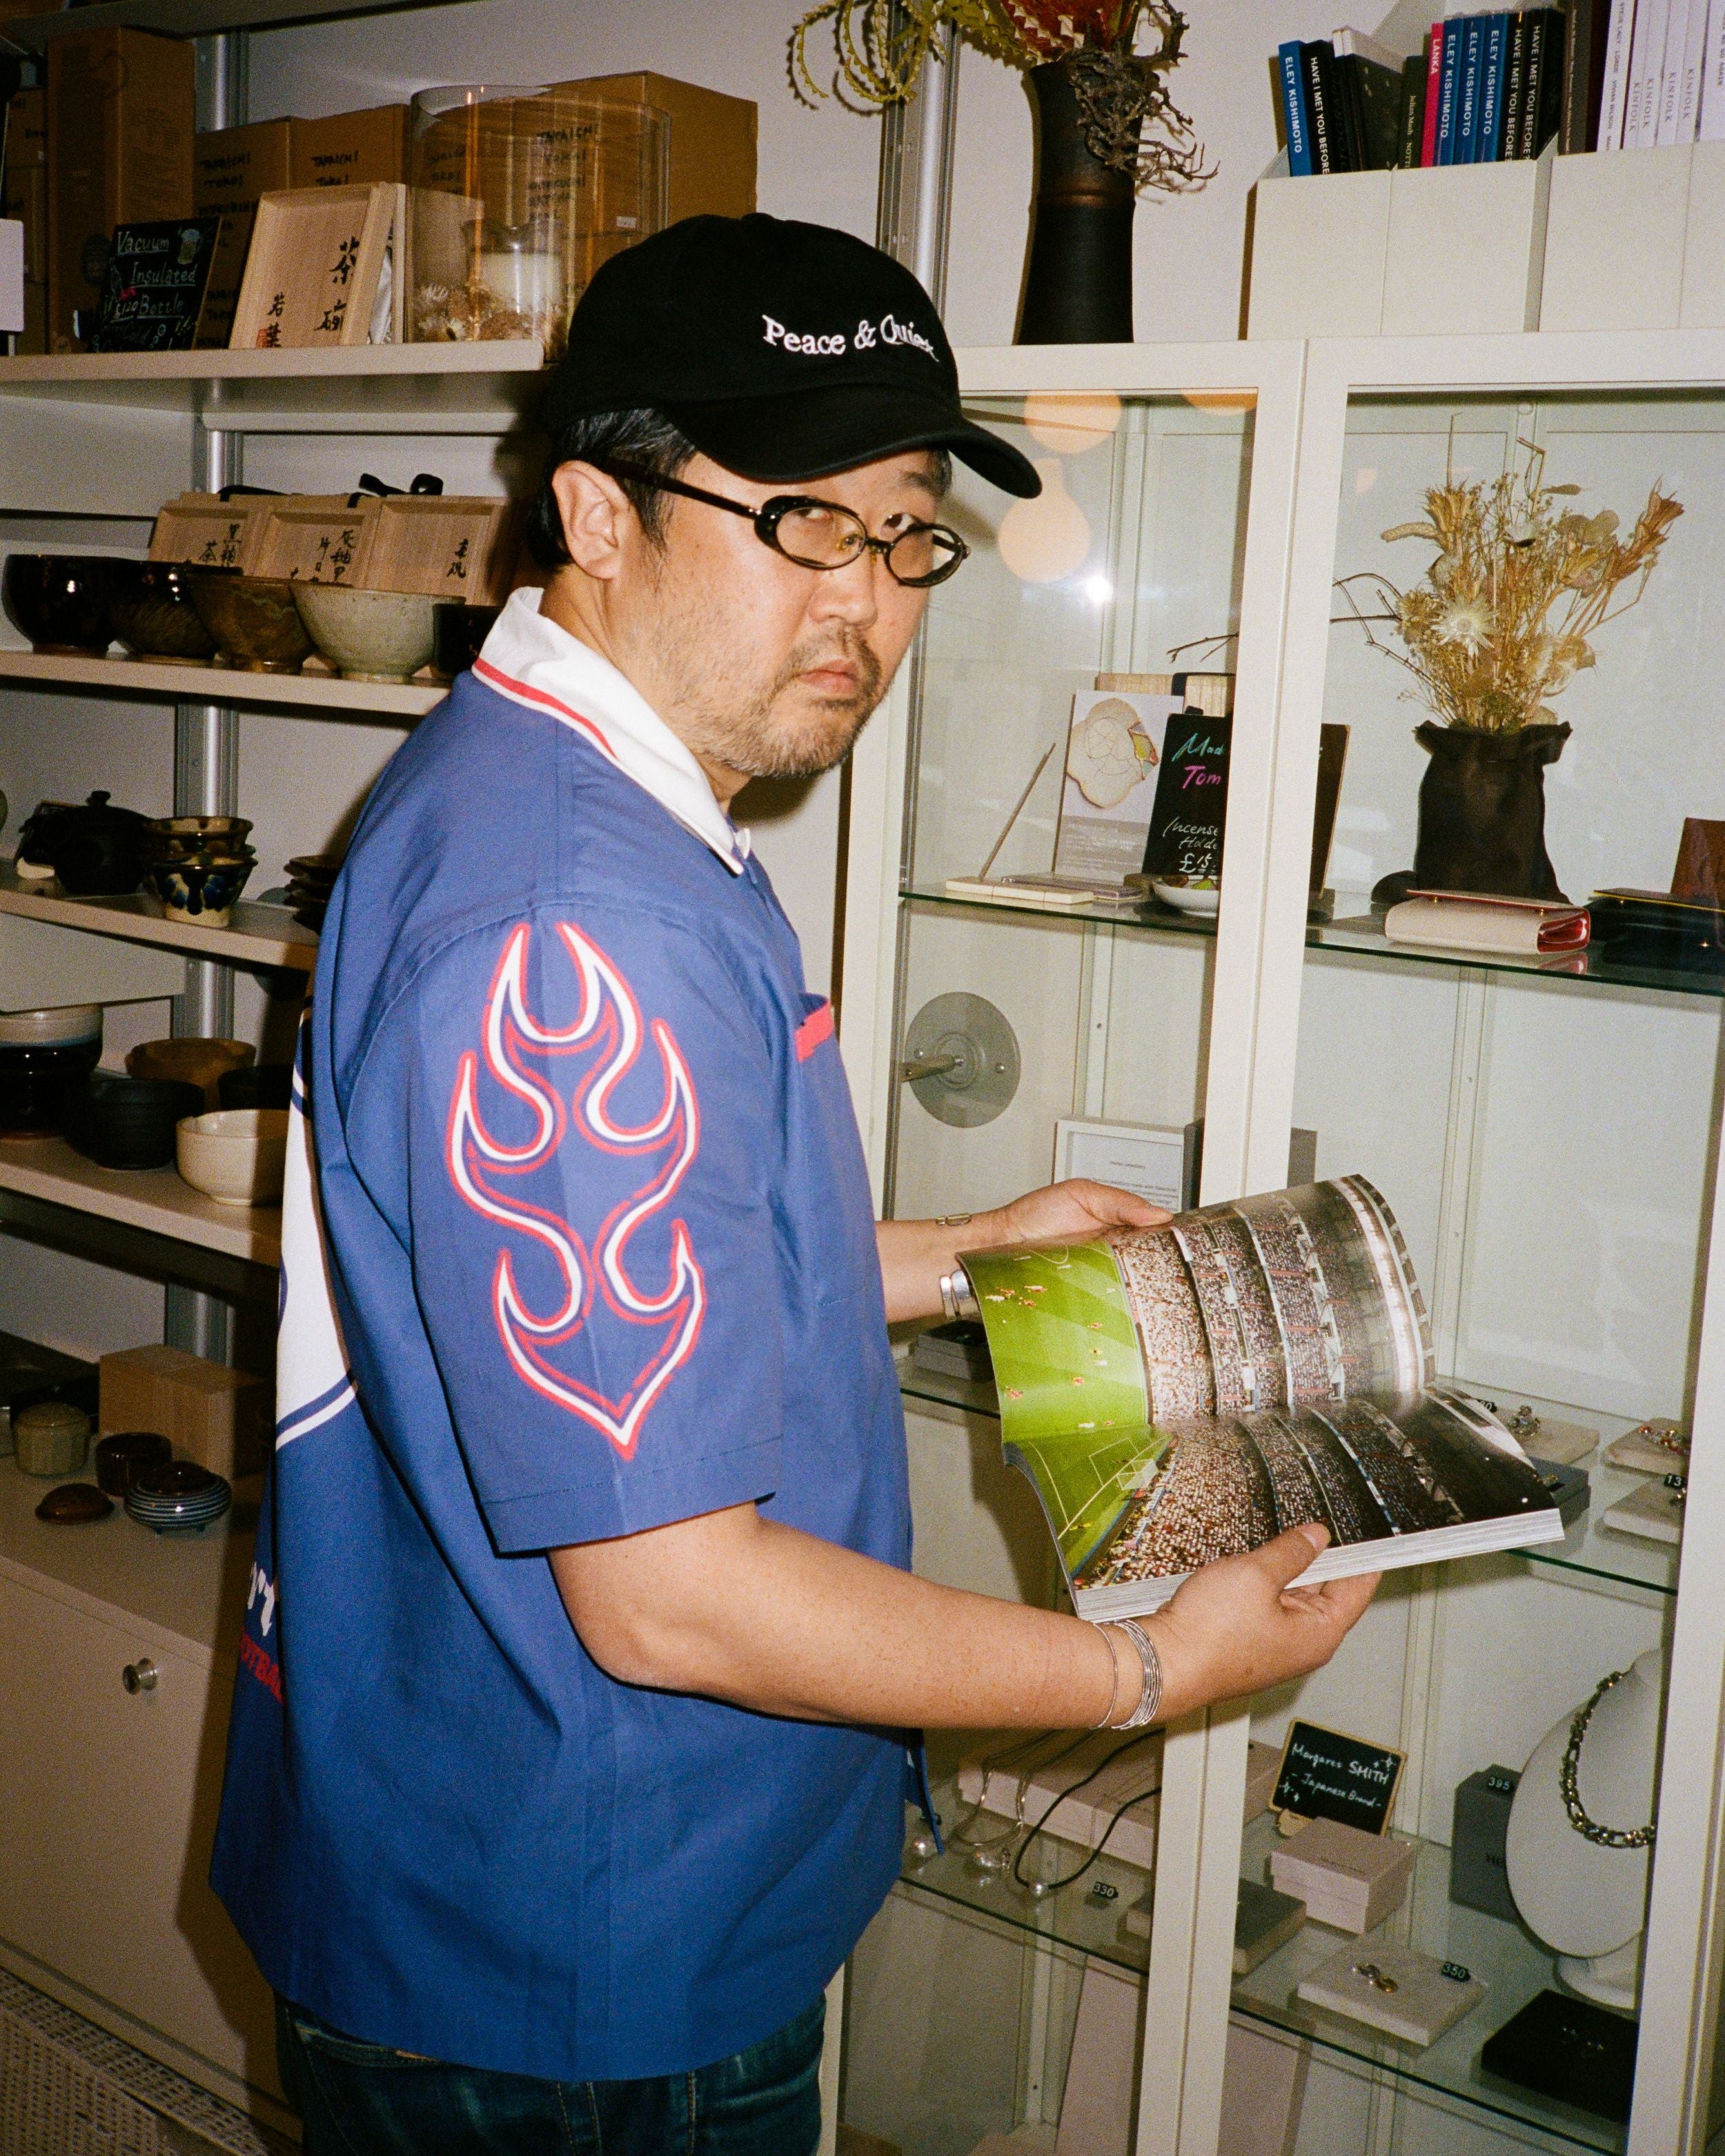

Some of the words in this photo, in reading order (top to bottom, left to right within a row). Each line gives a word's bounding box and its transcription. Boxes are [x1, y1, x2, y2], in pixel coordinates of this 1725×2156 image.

[1446, 34, 1456, 65] ELEY
[1468, 32, 1478, 62] ELEY
[1489, 30, 1499, 61] ELEY
[1512, 29, 1523, 58] HAVE
[1531, 26, 1541, 55] HAVE
[1285, 56, 1295, 85] ELEY
[1310, 57, 1321, 85] HAVE
[1430, 39, 1441, 75] LANKA
[1510, 68, 1520, 90] MET
[1528, 65, 1538, 86] MET
[1314, 90, 1323, 112] MET
[1440, 70, 1453, 138] KISHIMOTO
[1462, 68, 1475, 137] KISHIMOTO
[1483, 66, 1497, 135] KISHIMOTO
[1508, 92, 1518, 115] YOU
[1526, 88, 1535, 112] YOU
[1629, 82, 1640, 132] KINFOLK
[1642, 78, 1654, 128] KINFOLK
[1665, 72, 1677, 123] KINFOLK
[1683, 69, 1695, 119] KINFOLK
[1288, 88, 1303, 153] KISHIMOTO
[1316, 113, 1326, 135] YOU
[1403, 142, 1412, 168] NOTTI
[117, 230, 170, 254] Vacuum
[130, 261, 198, 285] Insulated
[140, 293, 185, 315] Bottle
[762, 314, 846, 355] Peace
[854, 319, 877, 350] &
[1172, 731, 1224, 762] Mad
[1182, 764, 1221, 789] Tom
[1163, 815, 1219, 838] Incense
[1179, 835, 1218, 850] Holde
[1348, 1760, 1390, 1786] SMITH
[1488, 1777, 1510, 1790] 395
[1094, 1883, 1115, 1897] 330
[1443, 1963, 1467, 1979] 350
